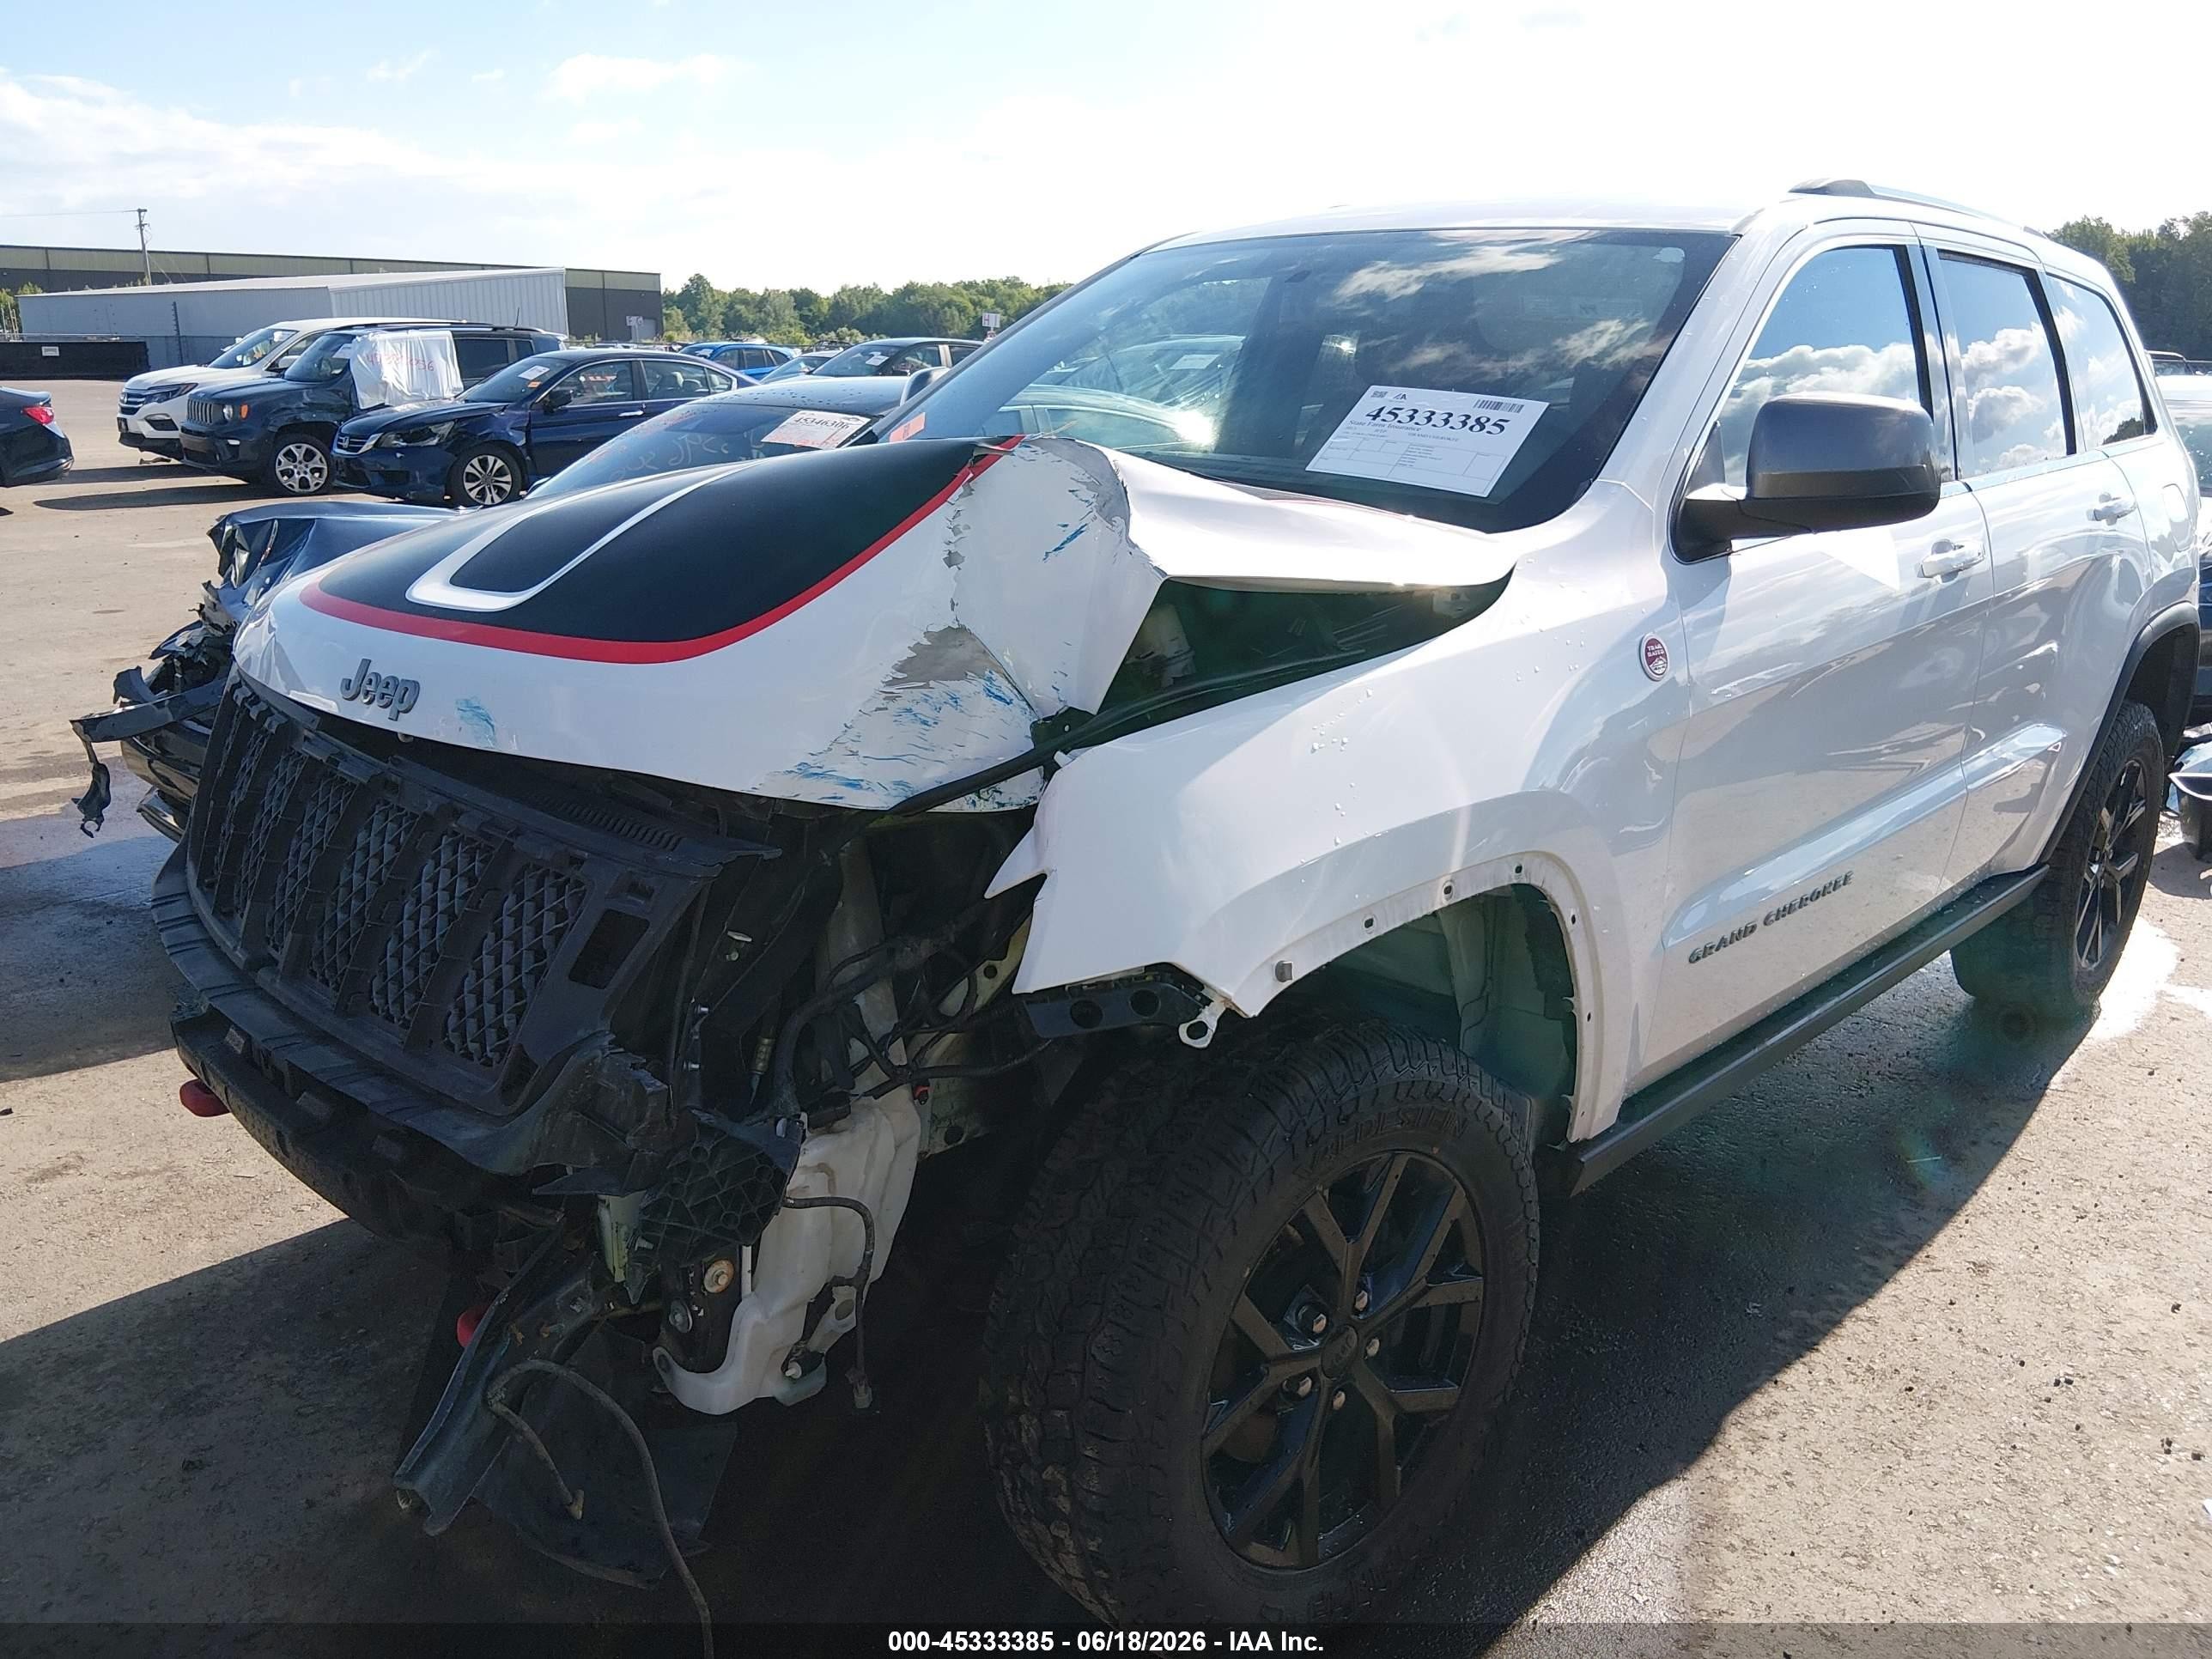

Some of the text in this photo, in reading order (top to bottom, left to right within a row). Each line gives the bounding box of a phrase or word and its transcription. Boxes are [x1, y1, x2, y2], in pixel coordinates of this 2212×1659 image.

[1365, 405, 1510, 435] 45333385
[340, 658, 420, 721] Jeep
[1688, 870, 1855, 963] GRAND CHEROKEE
